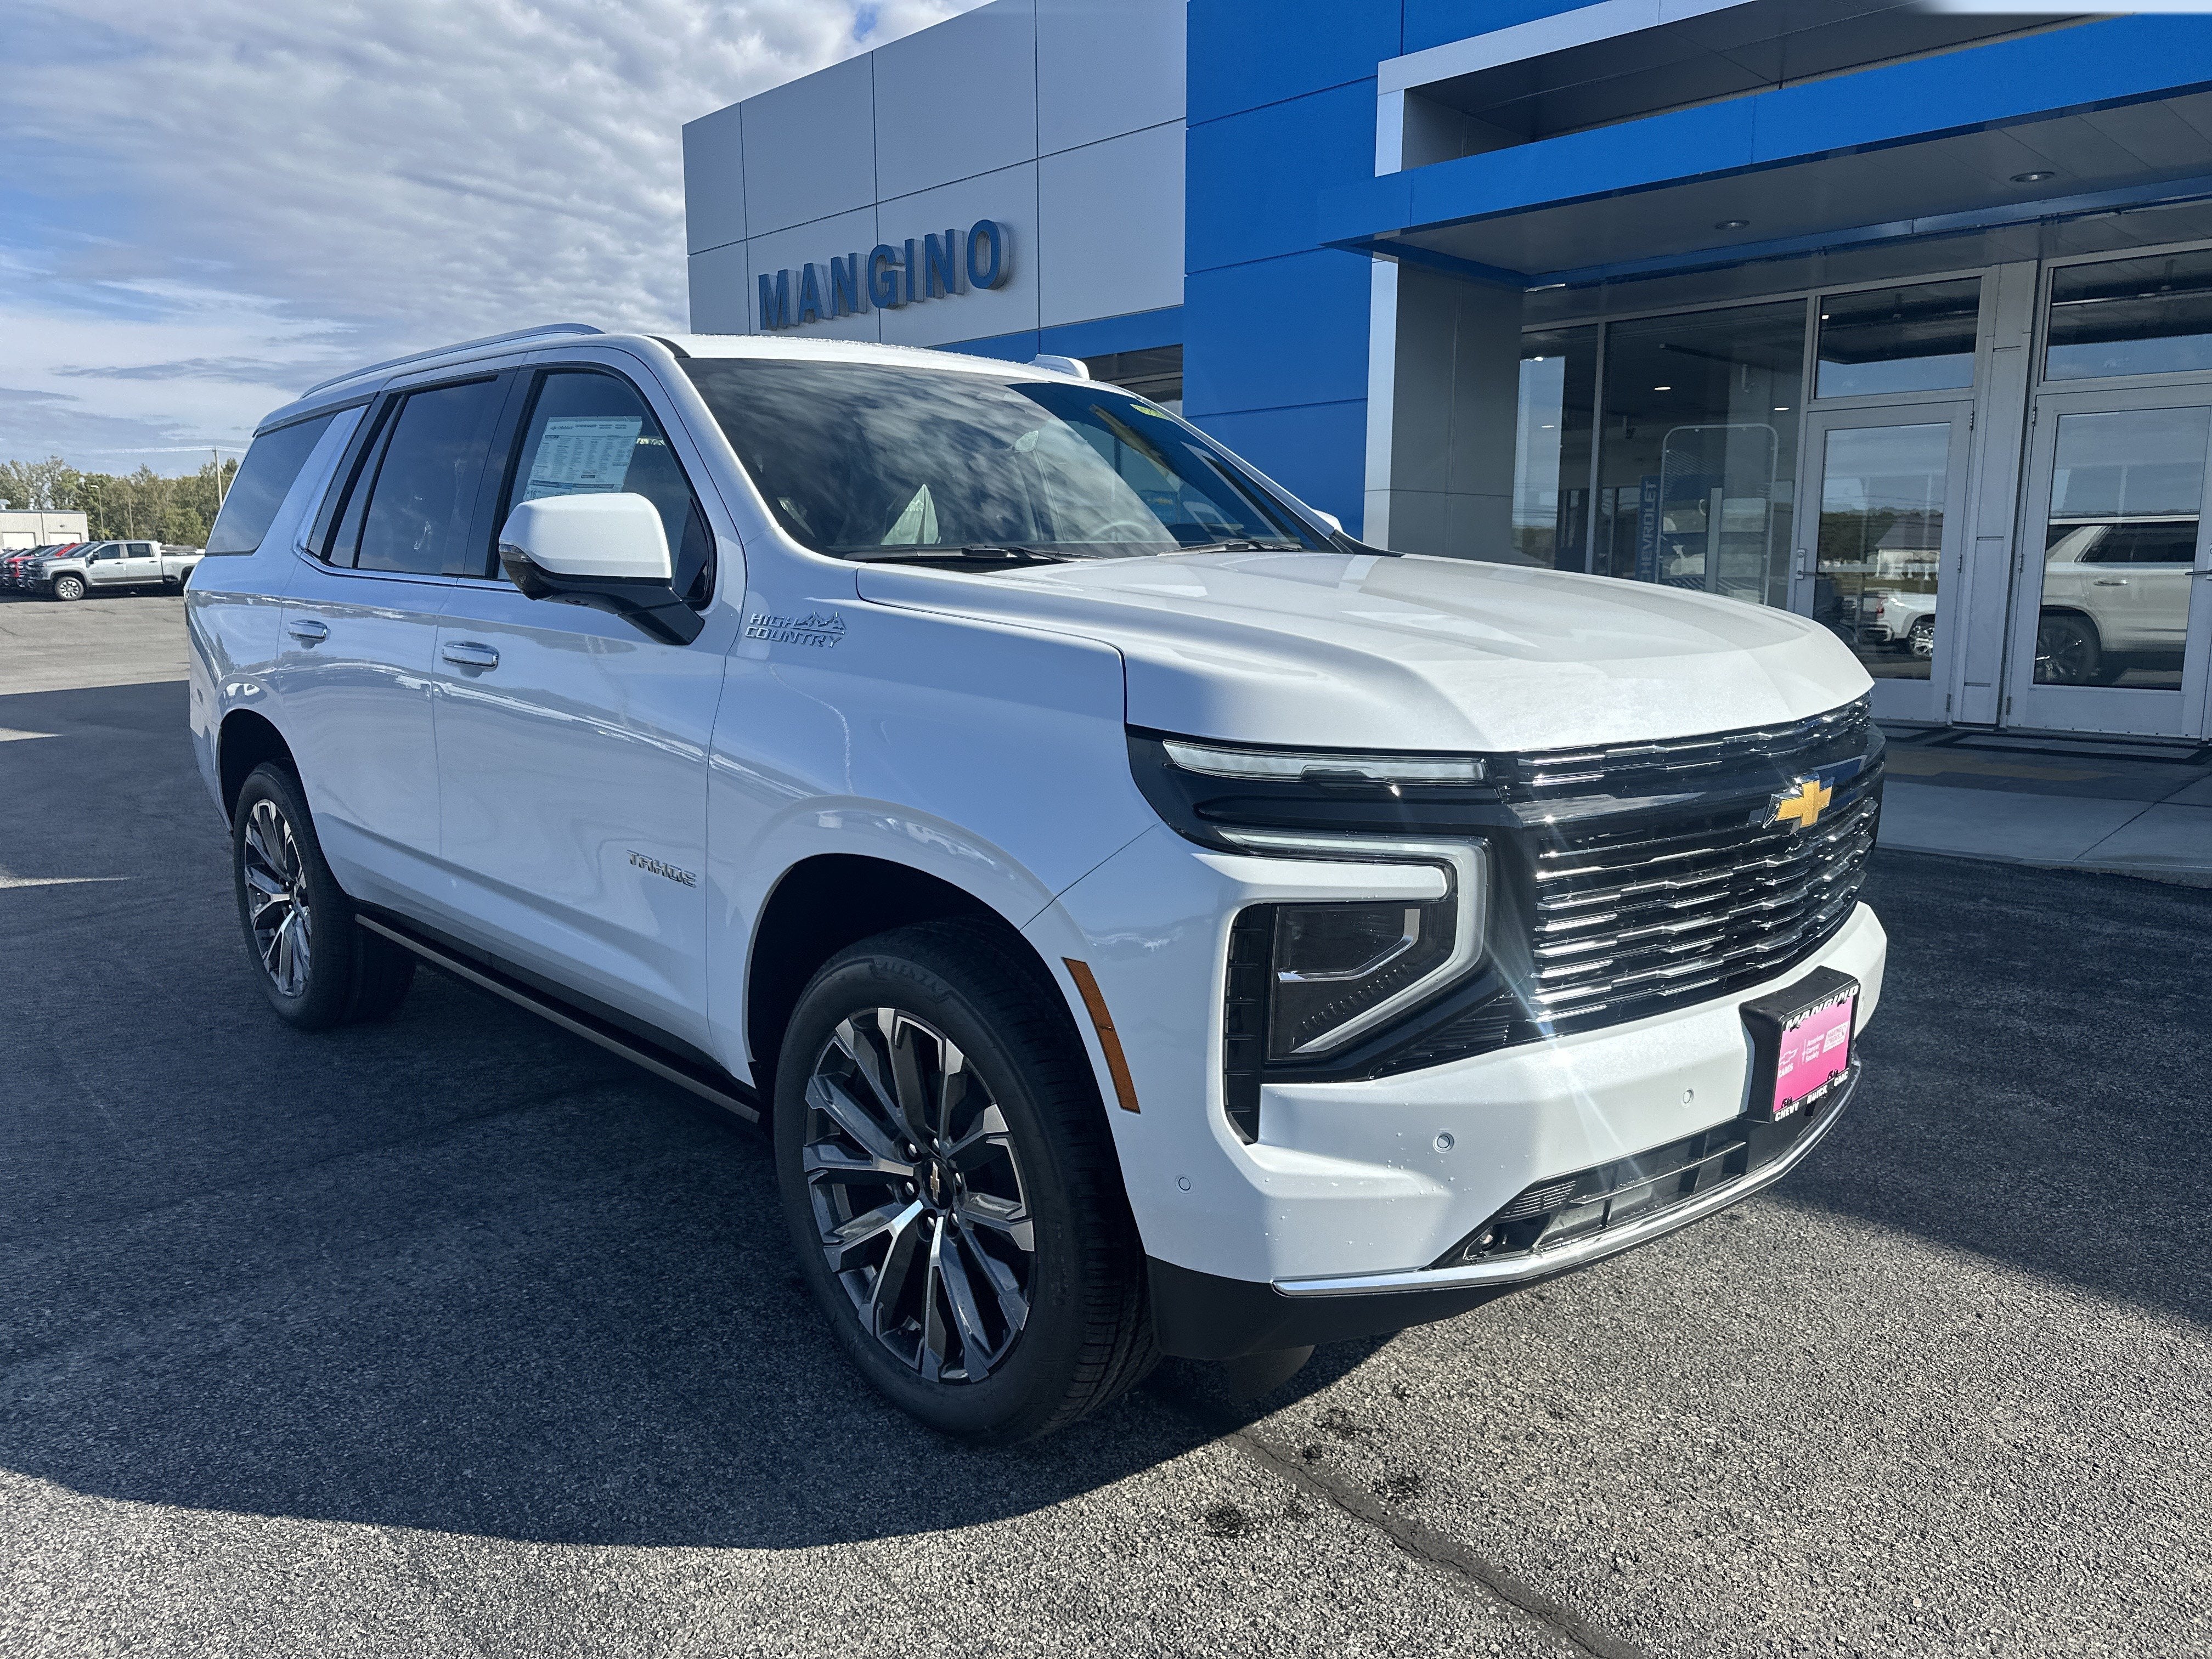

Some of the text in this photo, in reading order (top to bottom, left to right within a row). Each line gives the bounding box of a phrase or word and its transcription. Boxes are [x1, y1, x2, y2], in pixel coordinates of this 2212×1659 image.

[759, 219, 1007, 331] MANGINO
[745, 626, 843, 647] COUNTRY
[749, 613, 798, 628] HIGH
[627, 849, 696, 888] TAHOE
[1785, 985, 1859, 1031] MANGINO
[1775, 1070, 1848, 1121] CHEVY BUICK GMC
